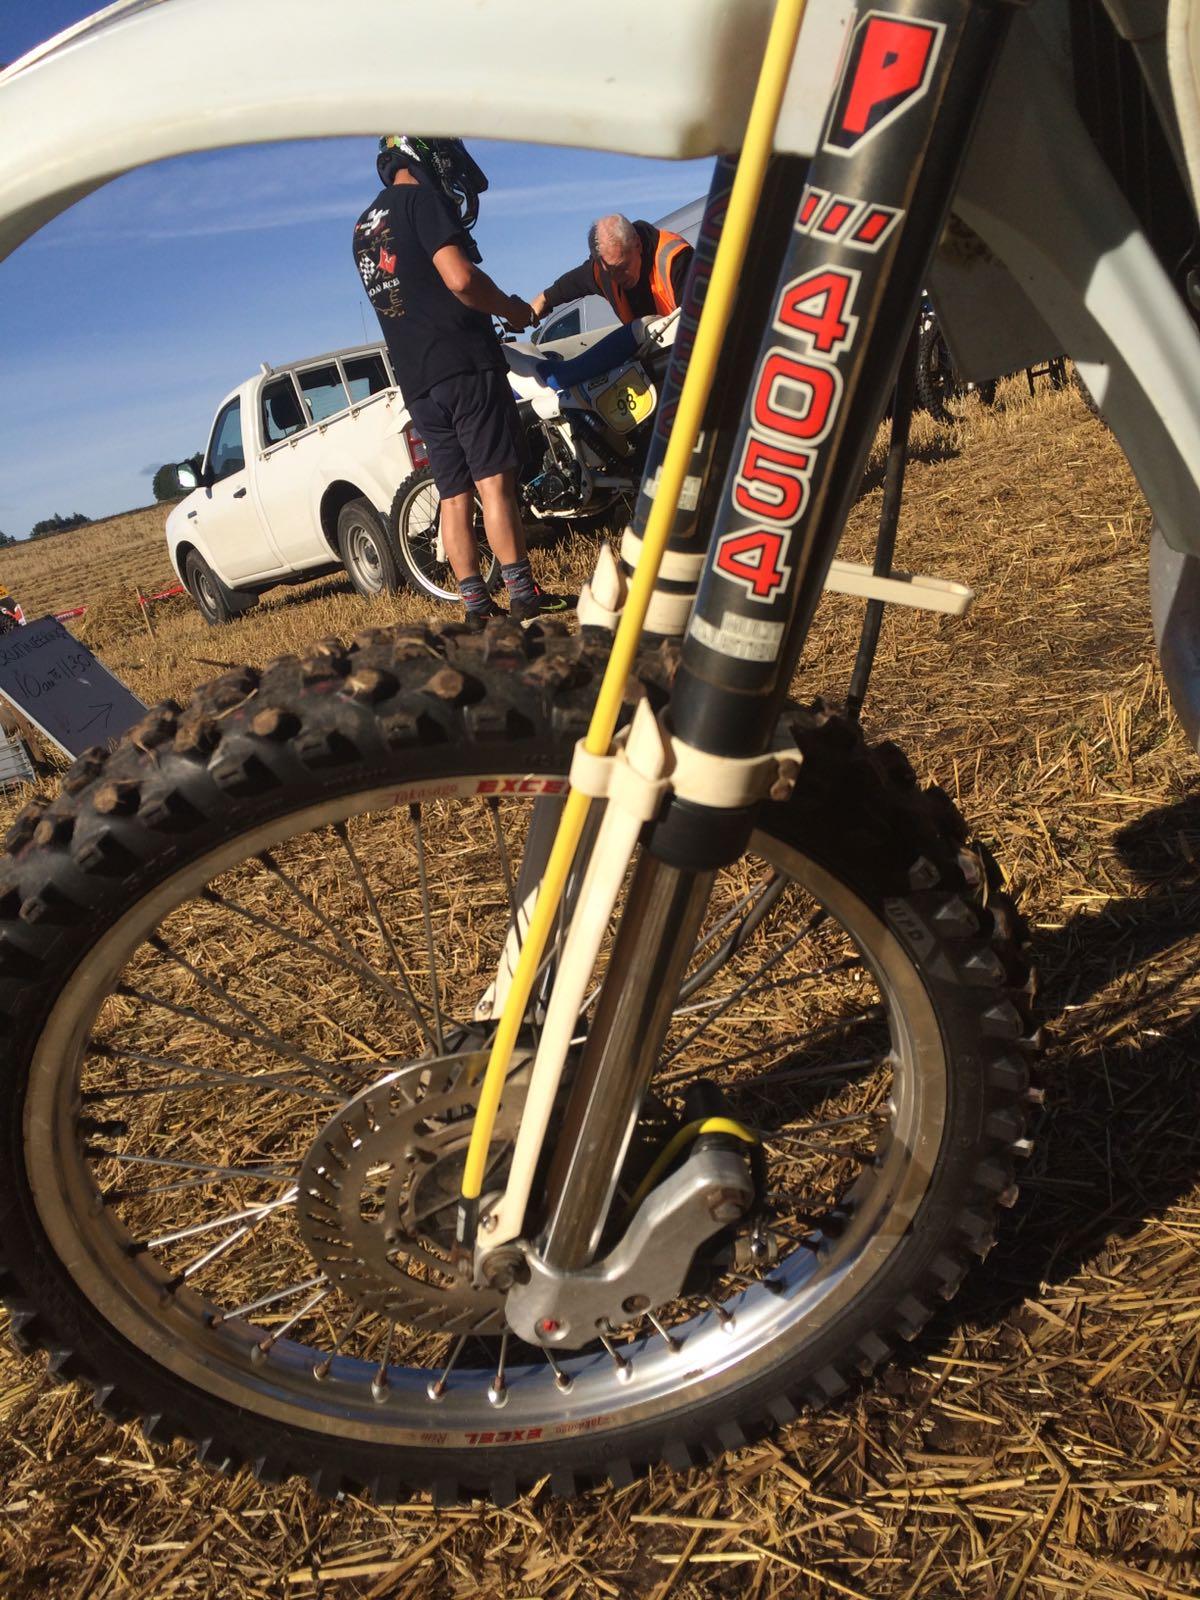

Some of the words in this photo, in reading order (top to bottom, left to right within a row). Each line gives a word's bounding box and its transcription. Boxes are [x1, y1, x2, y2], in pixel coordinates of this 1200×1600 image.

[617, 393, 637, 417] 98
[476, 779, 569, 795] EXCE
[464, 1427, 543, 1445] EXCEL
